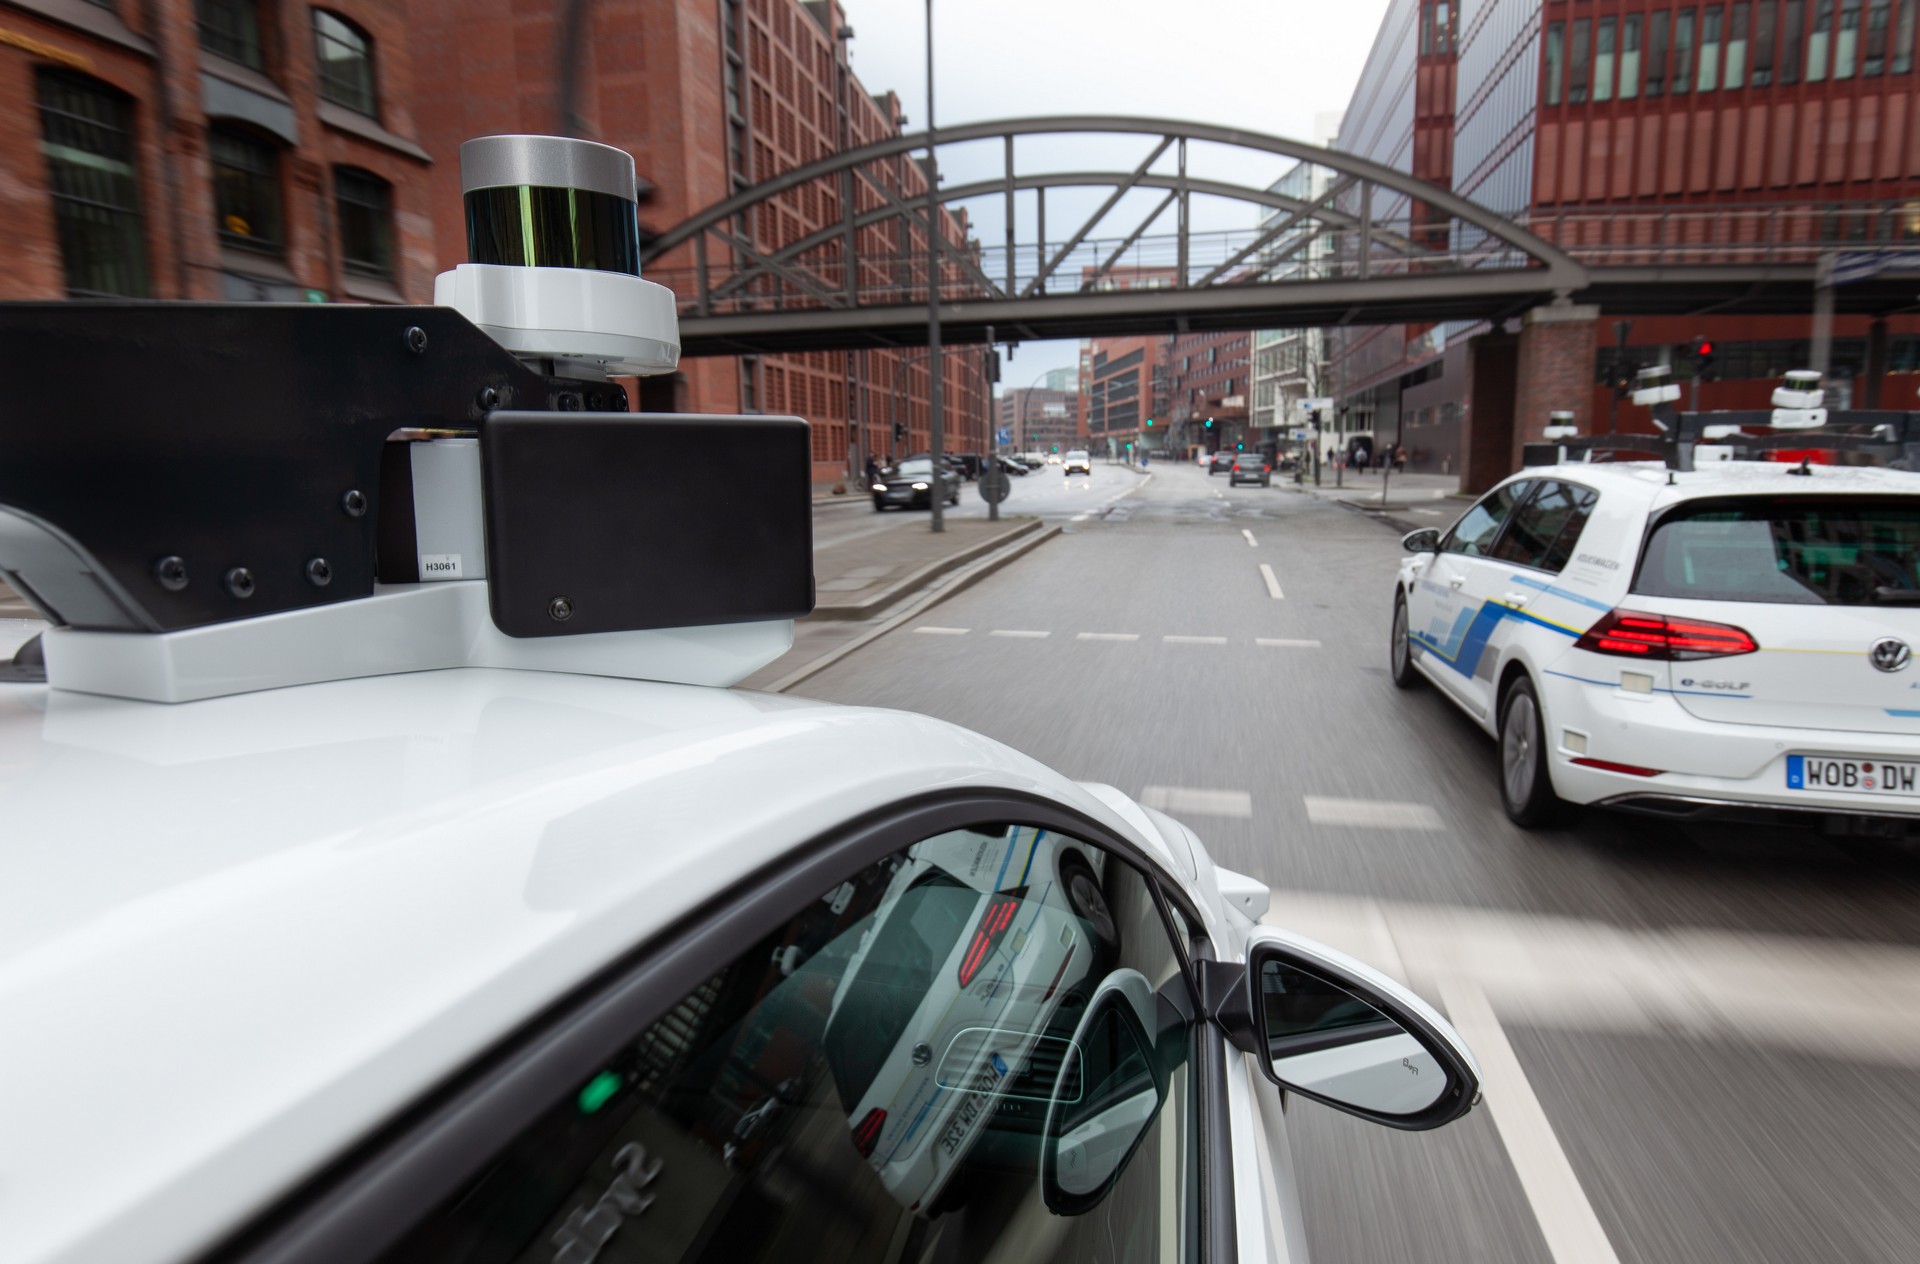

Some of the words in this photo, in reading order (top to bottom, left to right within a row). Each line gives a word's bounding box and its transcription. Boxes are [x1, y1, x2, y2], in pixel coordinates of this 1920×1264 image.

[426, 562, 456, 571] H3061
[1807, 760, 1858, 787] WOB
[1881, 765, 1916, 790] DW
